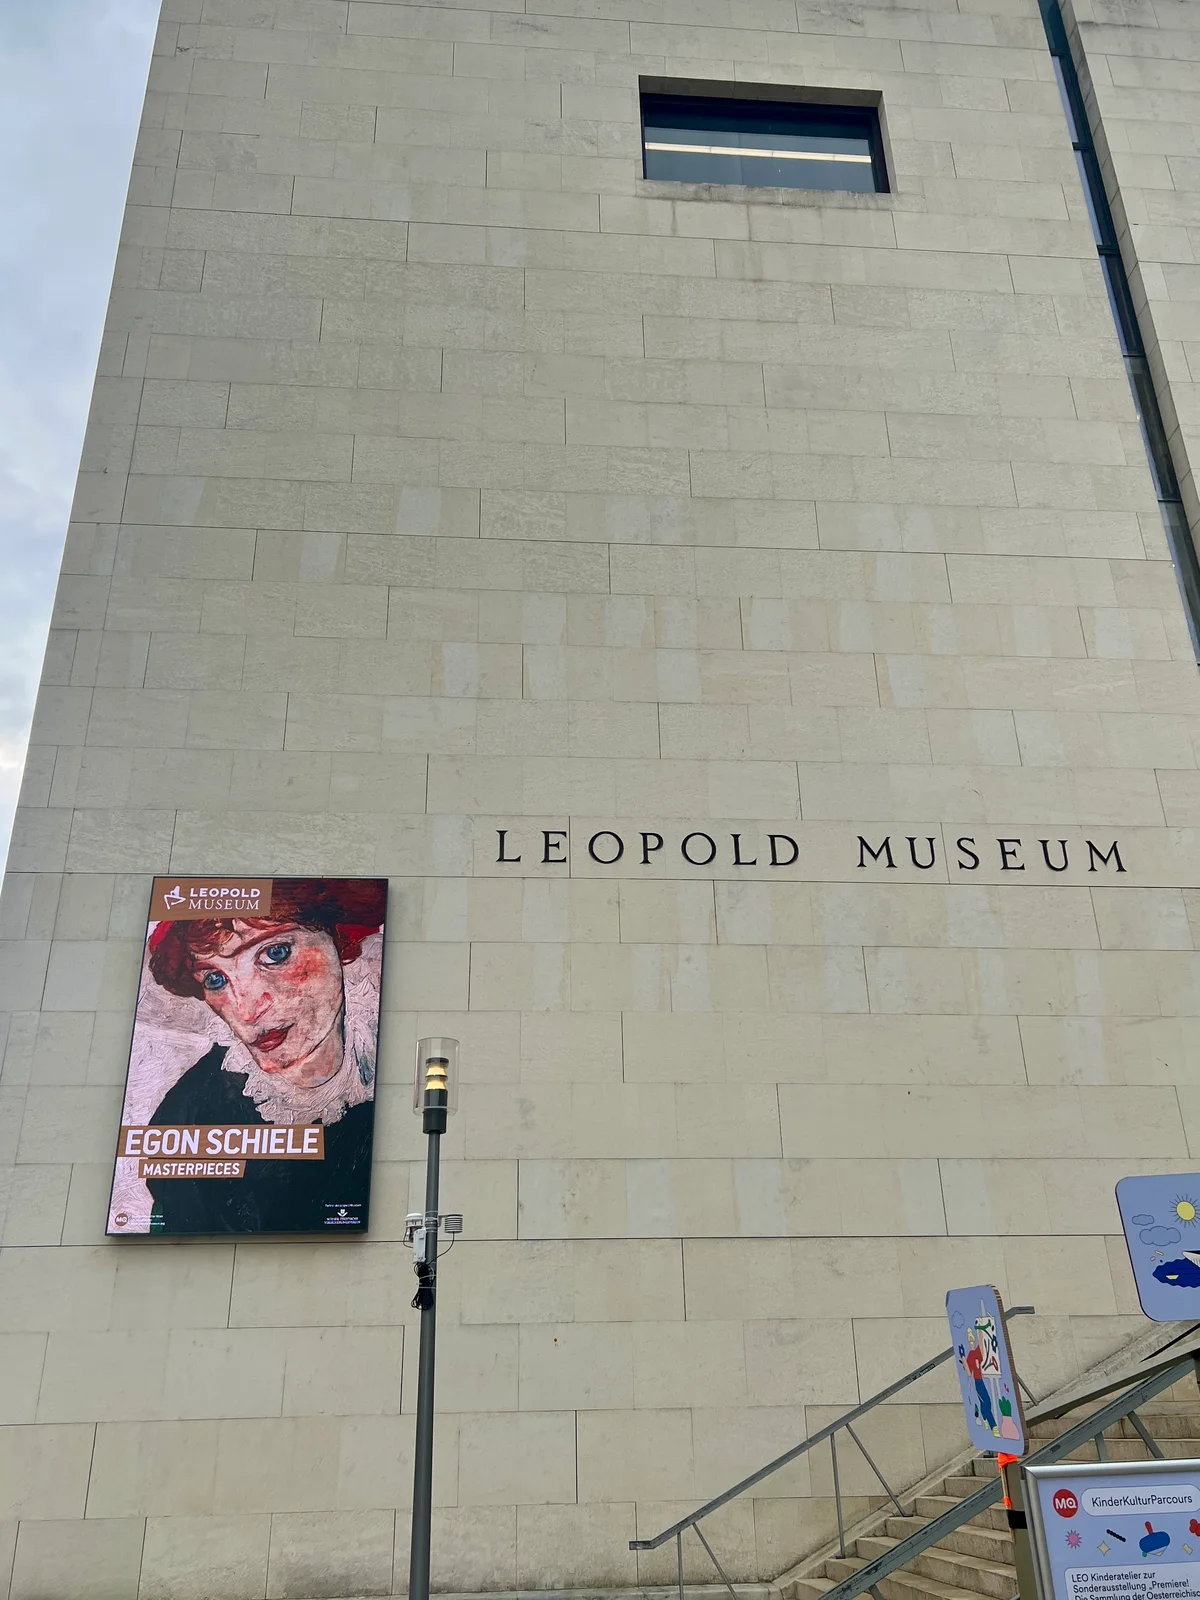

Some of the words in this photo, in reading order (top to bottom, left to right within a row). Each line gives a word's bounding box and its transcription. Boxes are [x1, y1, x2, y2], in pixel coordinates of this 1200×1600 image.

[496, 829, 800, 866] LEOPOLD
[856, 835, 1128, 873] MUSEUM
[189, 887, 261, 898] LEOPOLD
[188, 899, 260, 910] MUSEUM
[124, 1128, 200, 1155] EGON
[205, 1128, 320, 1155] SCHIELE
[142, 1162, 240, 1176] MASTERPIECES
[1054, 1497, 1077, 1510] MQ
[1091, 1494, 1193, 1508] KinderKulturParcours
[1071, 1573, 1089, 1583] LEO
[1090, 1571, 1141, 1582] Kinderatelier
[1073, 1582, 1147, 1594] Sonderausstellung
[1132, 1591, 1145, 1600] der
